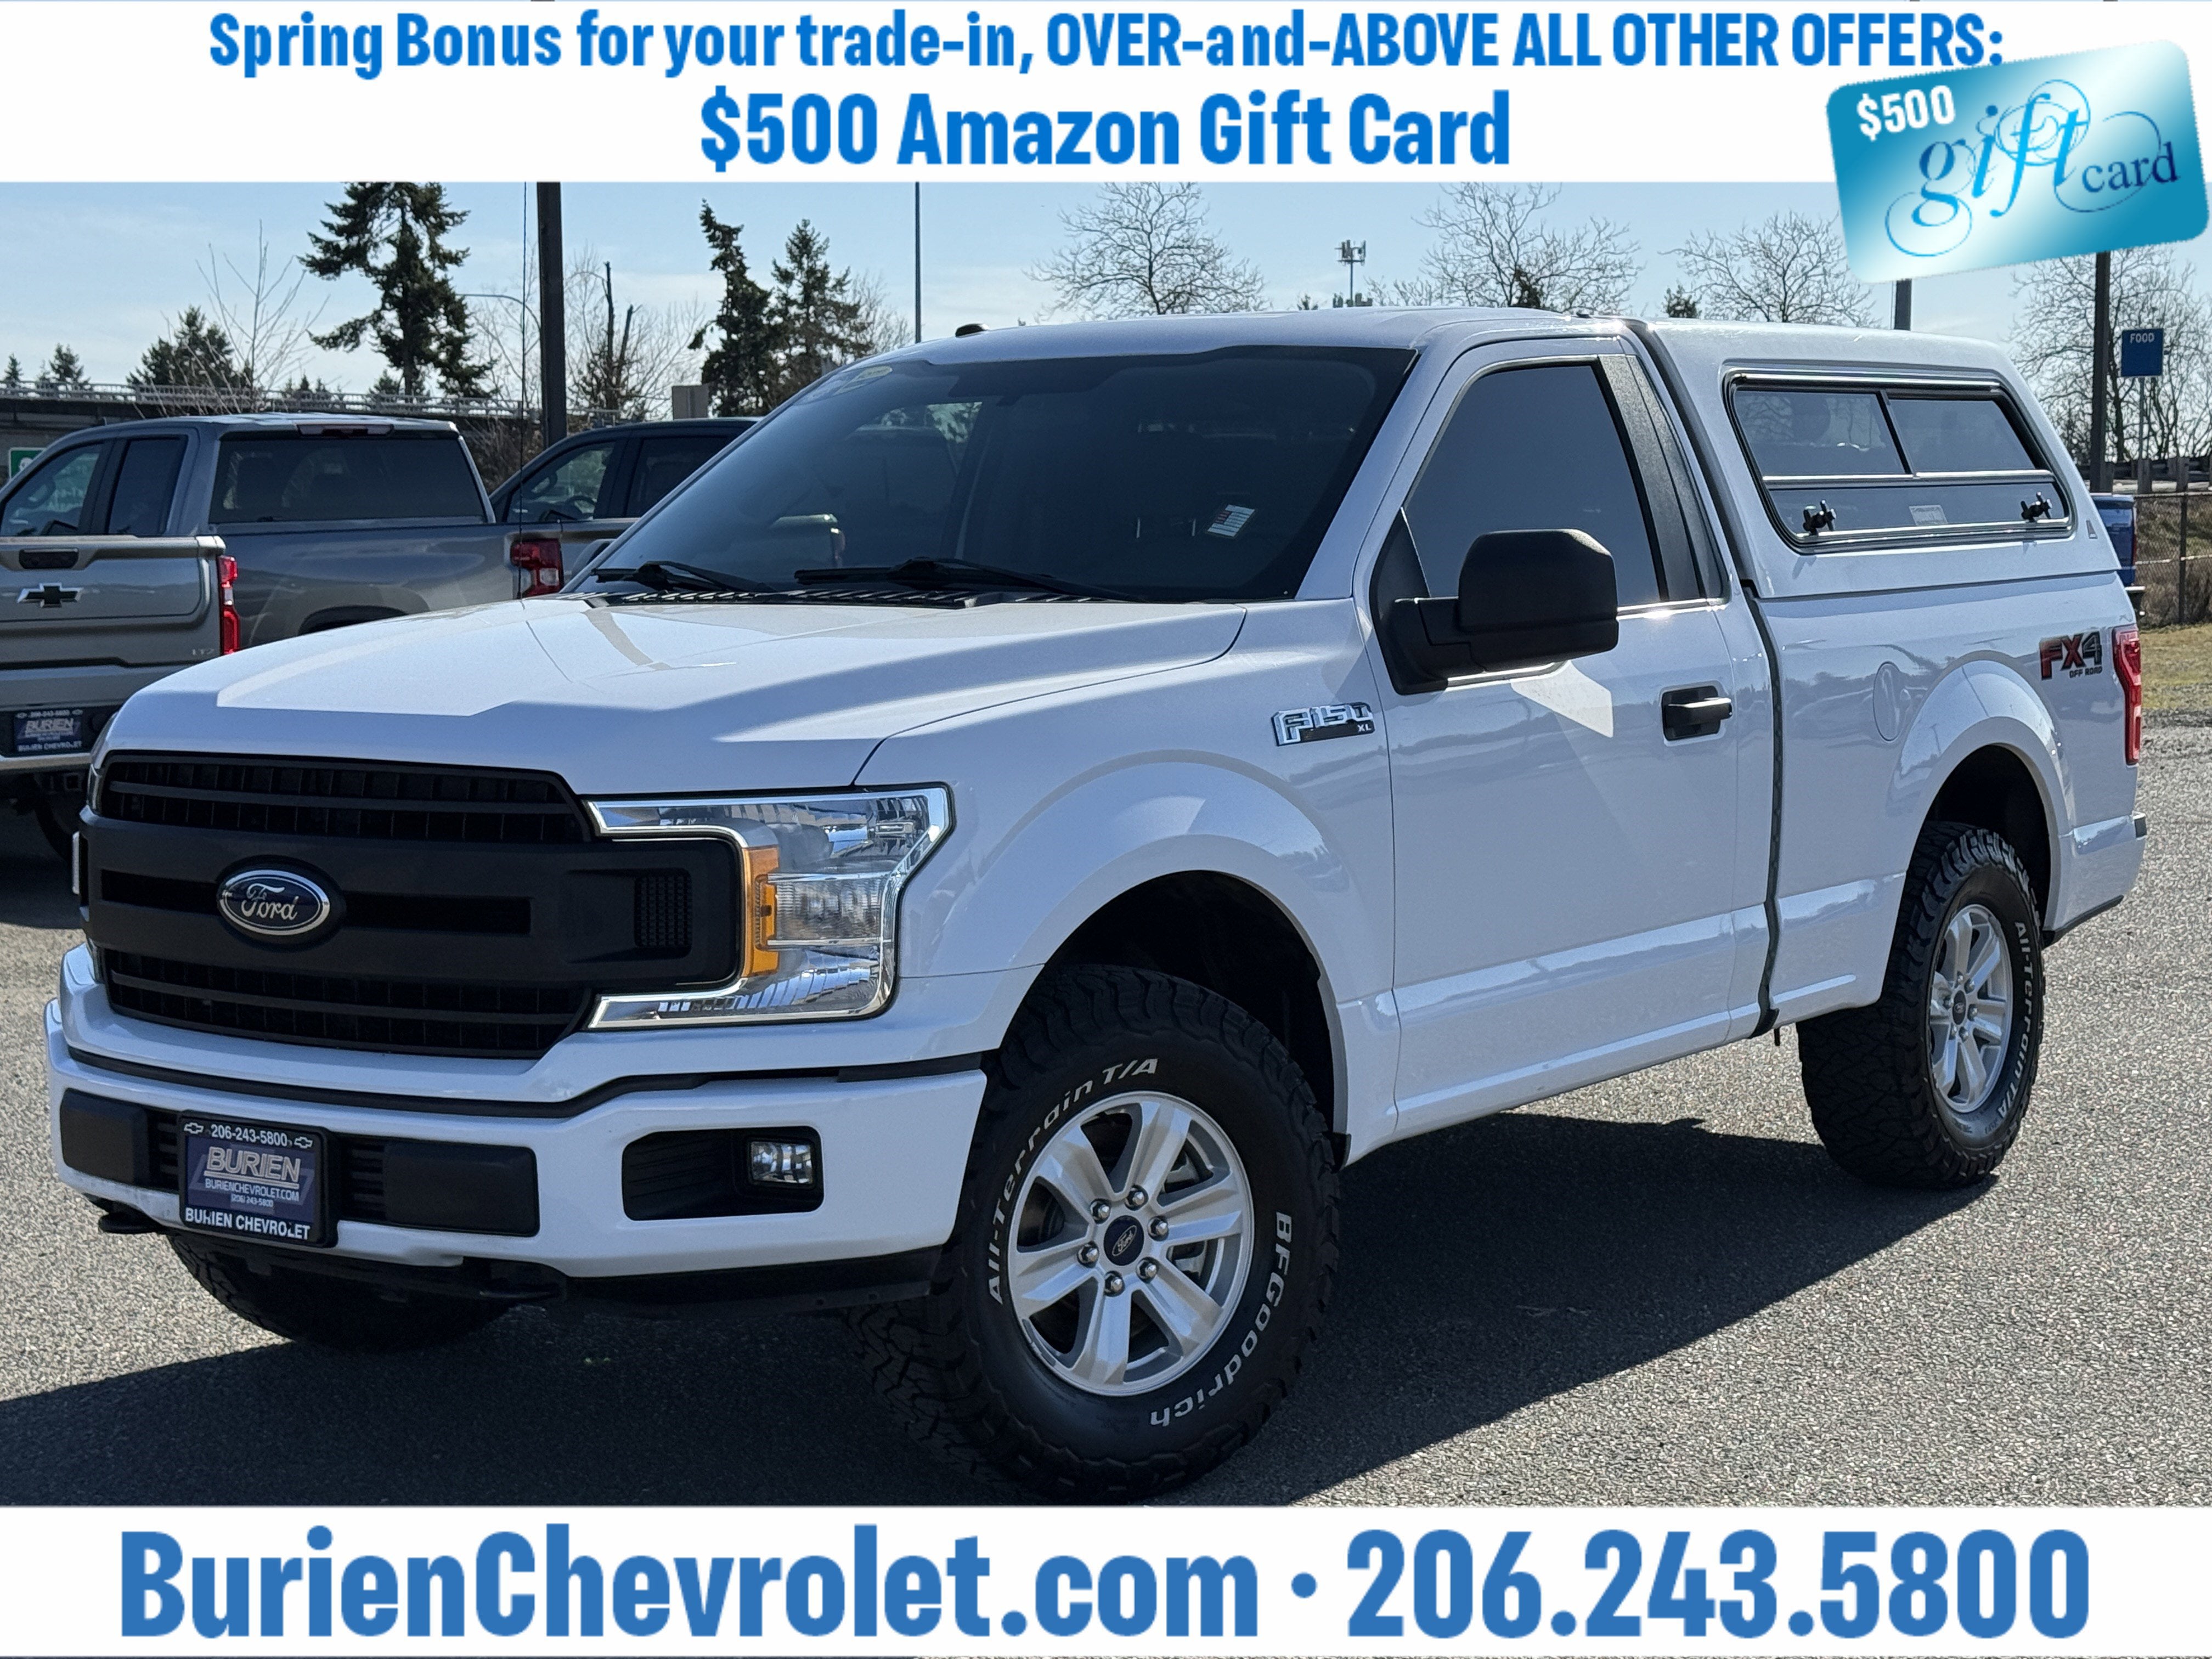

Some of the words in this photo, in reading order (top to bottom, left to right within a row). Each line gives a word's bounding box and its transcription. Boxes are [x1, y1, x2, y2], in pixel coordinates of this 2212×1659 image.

[2130, 332, 2154, 344] FOOD
[2039, 631, 2102, 680] FX4
[2069, 669, 2083, 678] OFF
[2085, 665, 2103, 675] ROAD
[26, 718, 74, 731] BURIEN
[1357, 724, 1372, 732] XL
[241, 883, 300, 921] Ford
[2015, 922, 2034, 1080] All-Terrain
[211, 1124, 287, 1147] 206-243-5800
[206, 1146, 301, 1182] BURIEN
[205, 1178, 300, 1201] BURIENCHEVROLET.COM
[989, 1080, 1093, 1305] All-Terrain
[1102, 1058, 1158, 1085] T/A
[1150, 1212, 1293, 1427] BFGoodrich
